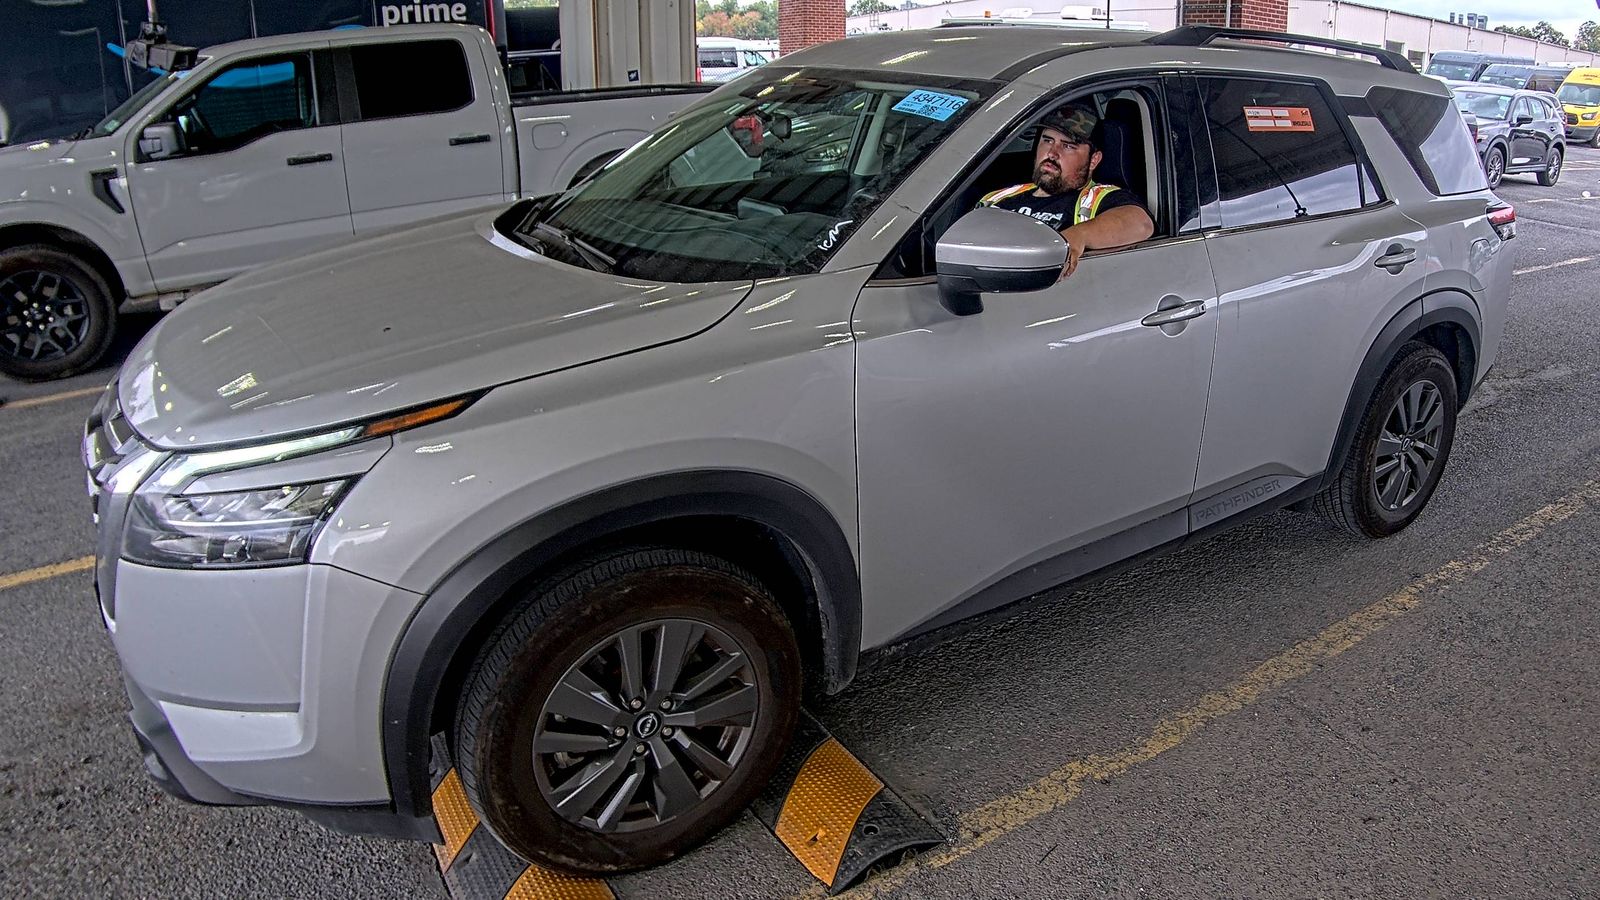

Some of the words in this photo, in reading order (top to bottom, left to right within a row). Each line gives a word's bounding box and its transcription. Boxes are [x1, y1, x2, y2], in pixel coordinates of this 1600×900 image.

[382, 0, 467, 27] prime
[913, 93, 965, 110] 4347116
[1194, 479, 1281, 522] PATHFINDER
